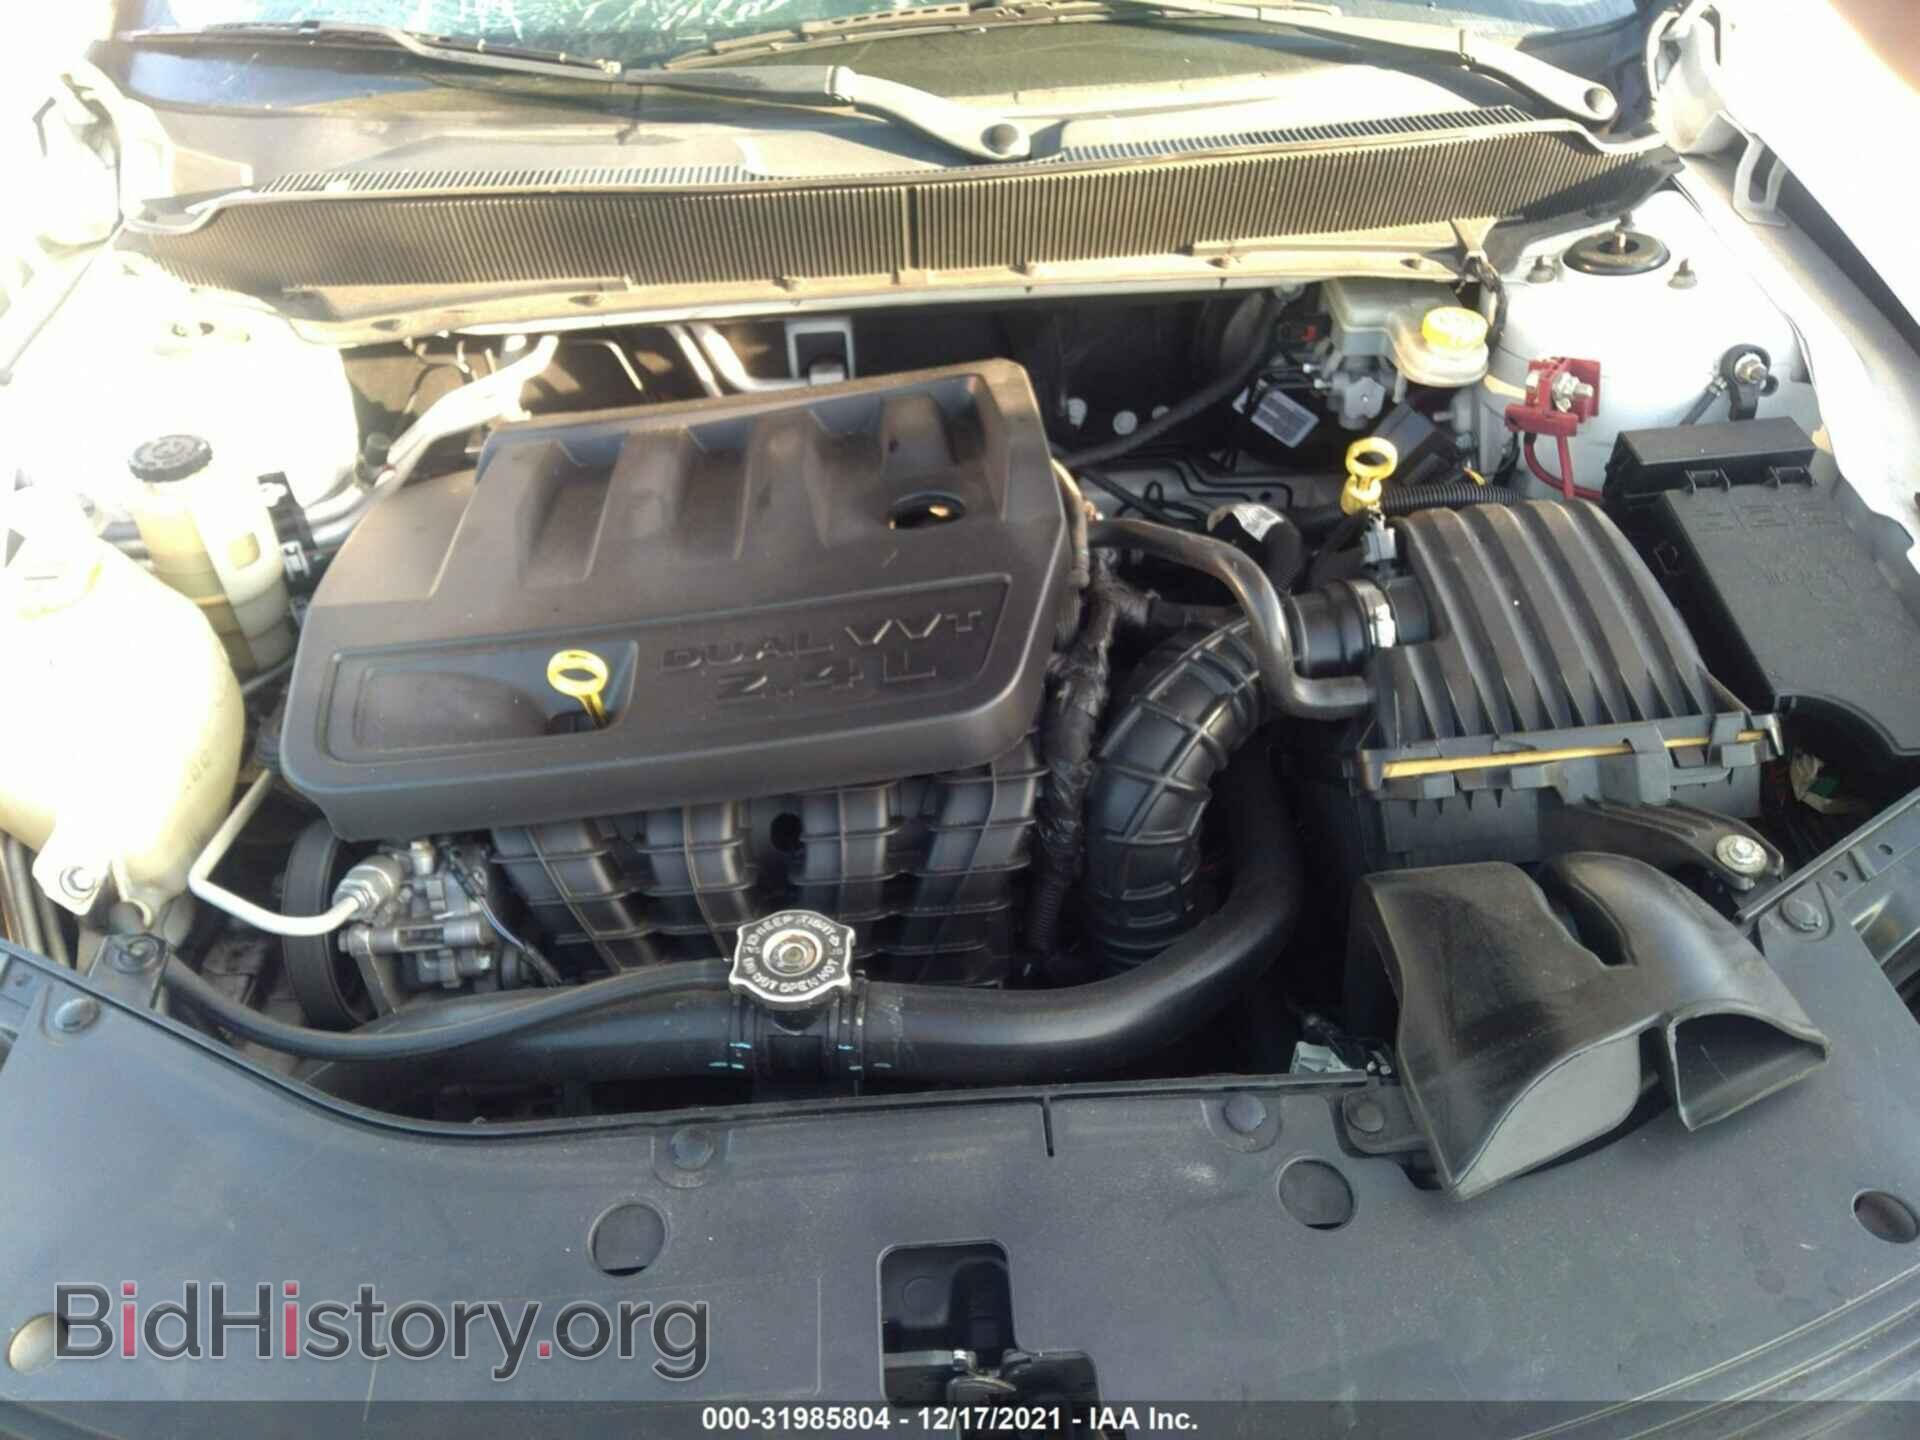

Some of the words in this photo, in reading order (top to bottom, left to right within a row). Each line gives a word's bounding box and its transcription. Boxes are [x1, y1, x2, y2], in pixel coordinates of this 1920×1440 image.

[659, 631, 836, 674] DUAL
[844, 610, 983, 646] VVT
[716, 651, 937, 704] 2.4L
[778, 977, 820, 993] OPEN
[816, 958, 841, 982] HOT
